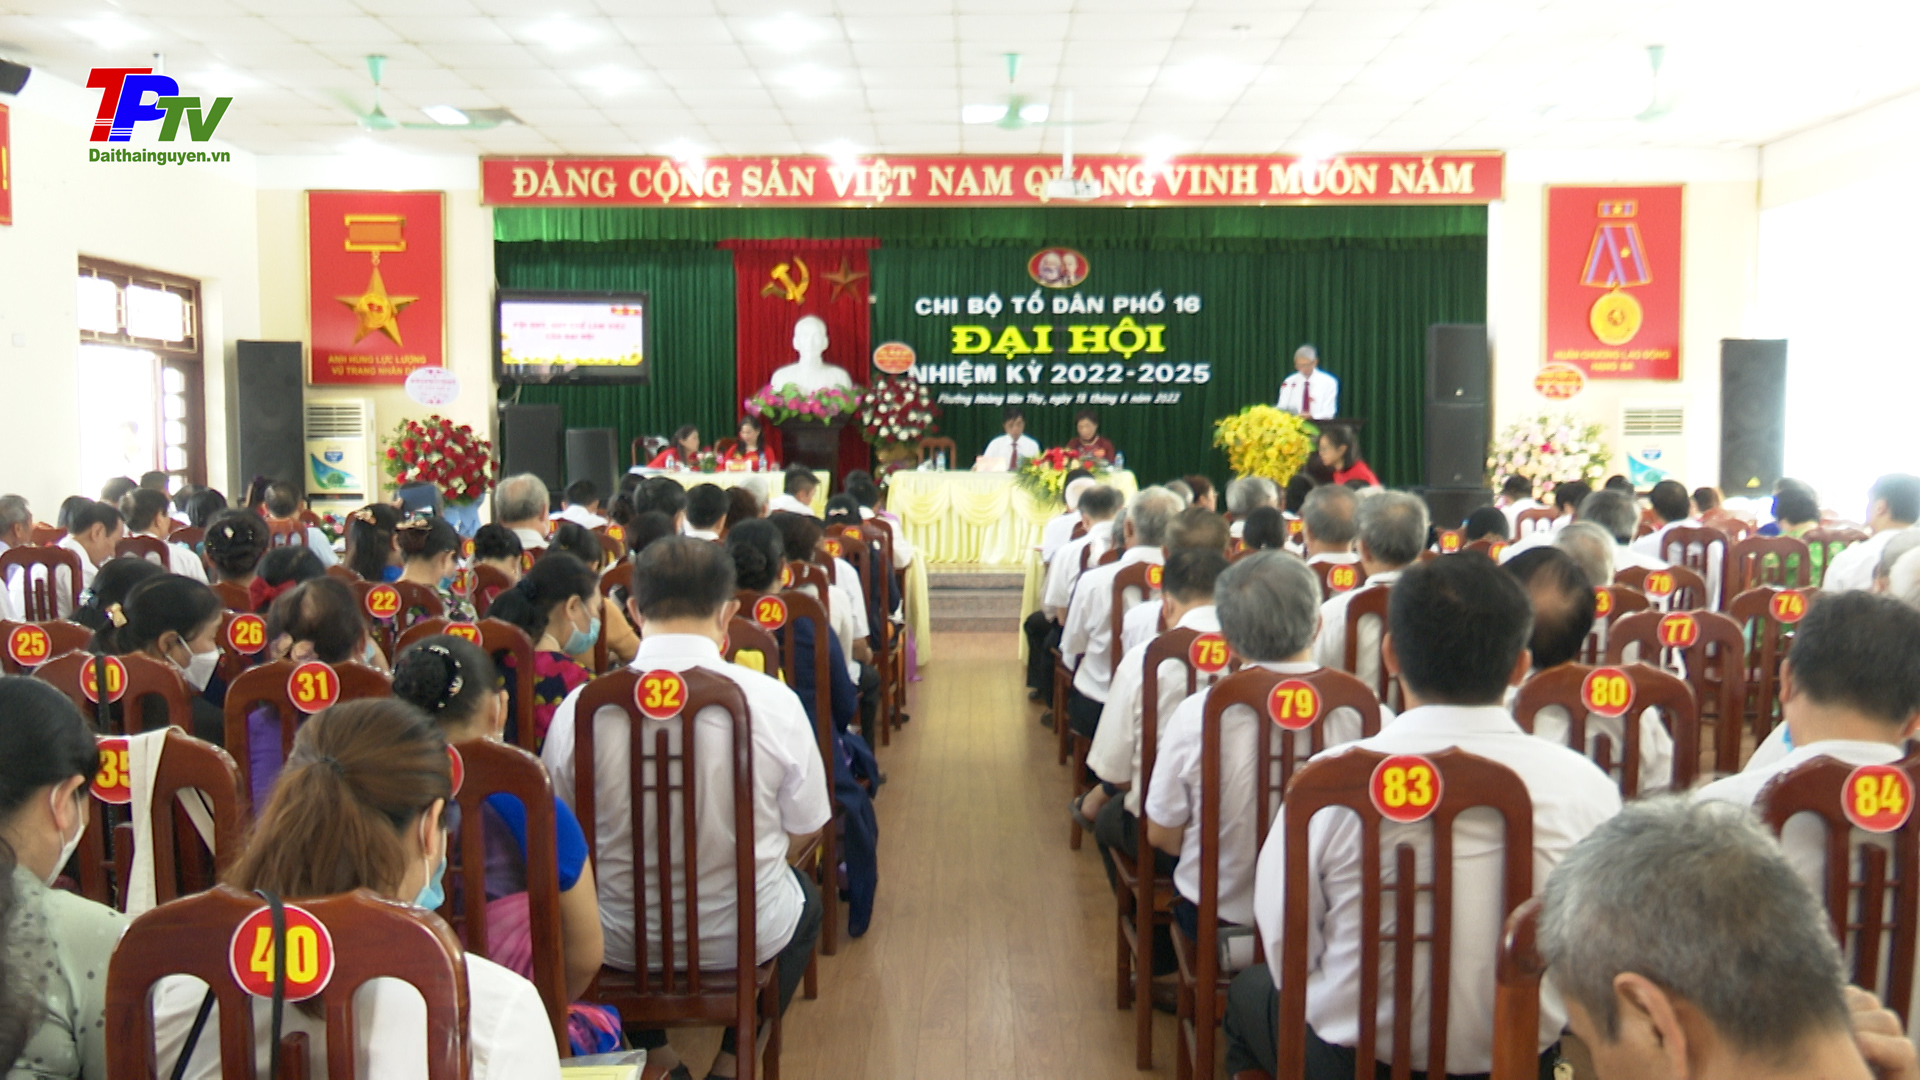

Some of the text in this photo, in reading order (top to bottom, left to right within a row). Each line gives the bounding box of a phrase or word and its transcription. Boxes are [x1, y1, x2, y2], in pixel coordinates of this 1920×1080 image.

[513, 158, 617, 198] ĐẢNG
[629, 159, 731, 204] CỘNG
[741, 158, 816, 197] SẢN
[827, 158, 916, 203] VIỆT
[928, 165, 1014, 197] NAM
[1161, 164, 1259, 197] VINH
[1268, 158, 1380, 196] MUÔN
[1388, 157, 1475, 195] NĂM
[915, 296, 959, 315] CHI
[967, 290, 1002, 318] BỘ
[1052, 291, 1105, 315] DÂN
[1112, 288, 1166, 315] PHỐ
[951, 324, 1053, 360] ĐẠI
[1067, 315, 1166, 360] HỘI
[907, 359, 997, 388] NHIỆM
[1050, 363, 1212, 385] 2022-2025
[372, 592, 396, 611] 22
[759, 602, 783, 622] 24
[1776, 594, 1803, 615] 74
[16, 634, 46, 656] 25
[235, 622, 263, 645] 26
[1664, 618, 1692, 643] 77
[1197, 641, 1226, 664] 75
[298, 674, 329, 700] 31
[644, 678, 680, 708] 32
[1590, 676, 1627, 707] 80
[1276, 688, 1315, 720] 79
[1382, 764, 1433, 808] 83
[1854, 774, 1904, 816] 84
[250, 925, 318, 984] 40
